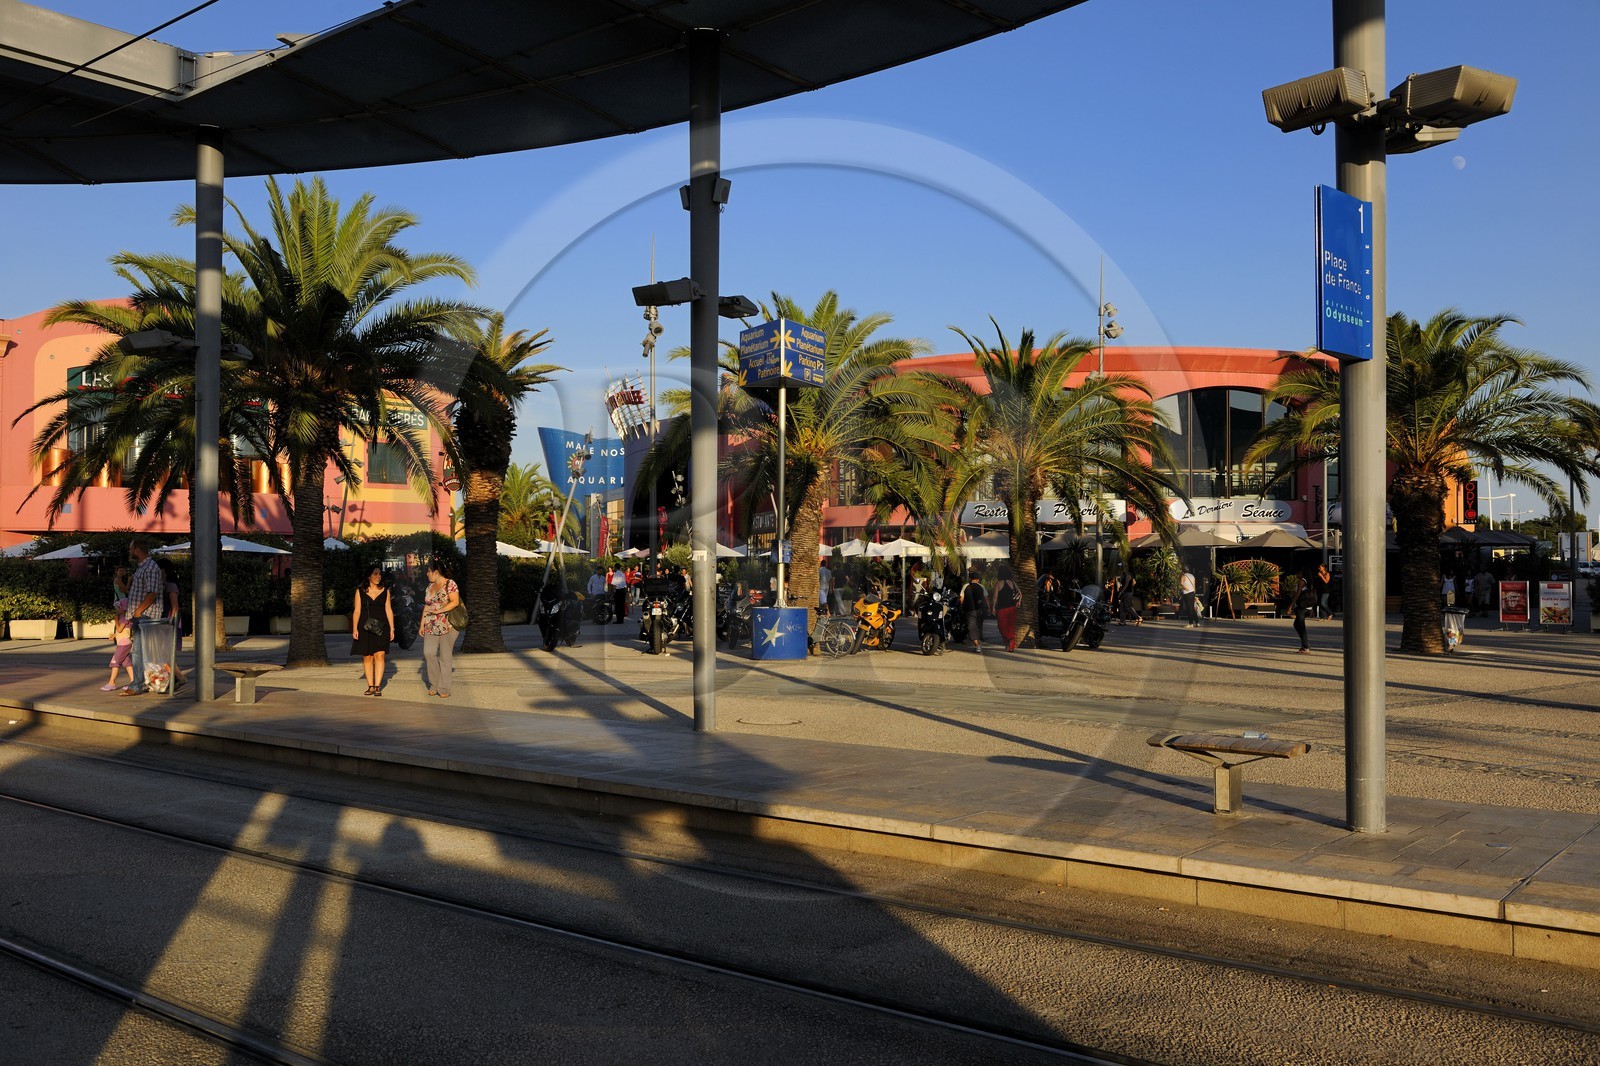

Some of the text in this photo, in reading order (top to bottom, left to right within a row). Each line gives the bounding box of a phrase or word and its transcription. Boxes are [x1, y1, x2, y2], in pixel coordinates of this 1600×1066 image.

[1358, 204, 1364, 233] 1
[1324, 250, 1347, 272] Place
[1325, 270, 1361, 295] de France
[1325, 307, 1363, 327] Odysseum
[741, 328, 764, 344] Aquarium
[801, 327, 824, 344] Aquarium
[740, 340, 769, 356] Planétarium
[796, 338, 824, 357] Planétarium
[749, 354, 764, 369] Accueil
[799, 354, 824, 371] Parking P2
[757, 365, 780, 380] Patinoire
[1241, 504, 1285, 519] Séance
